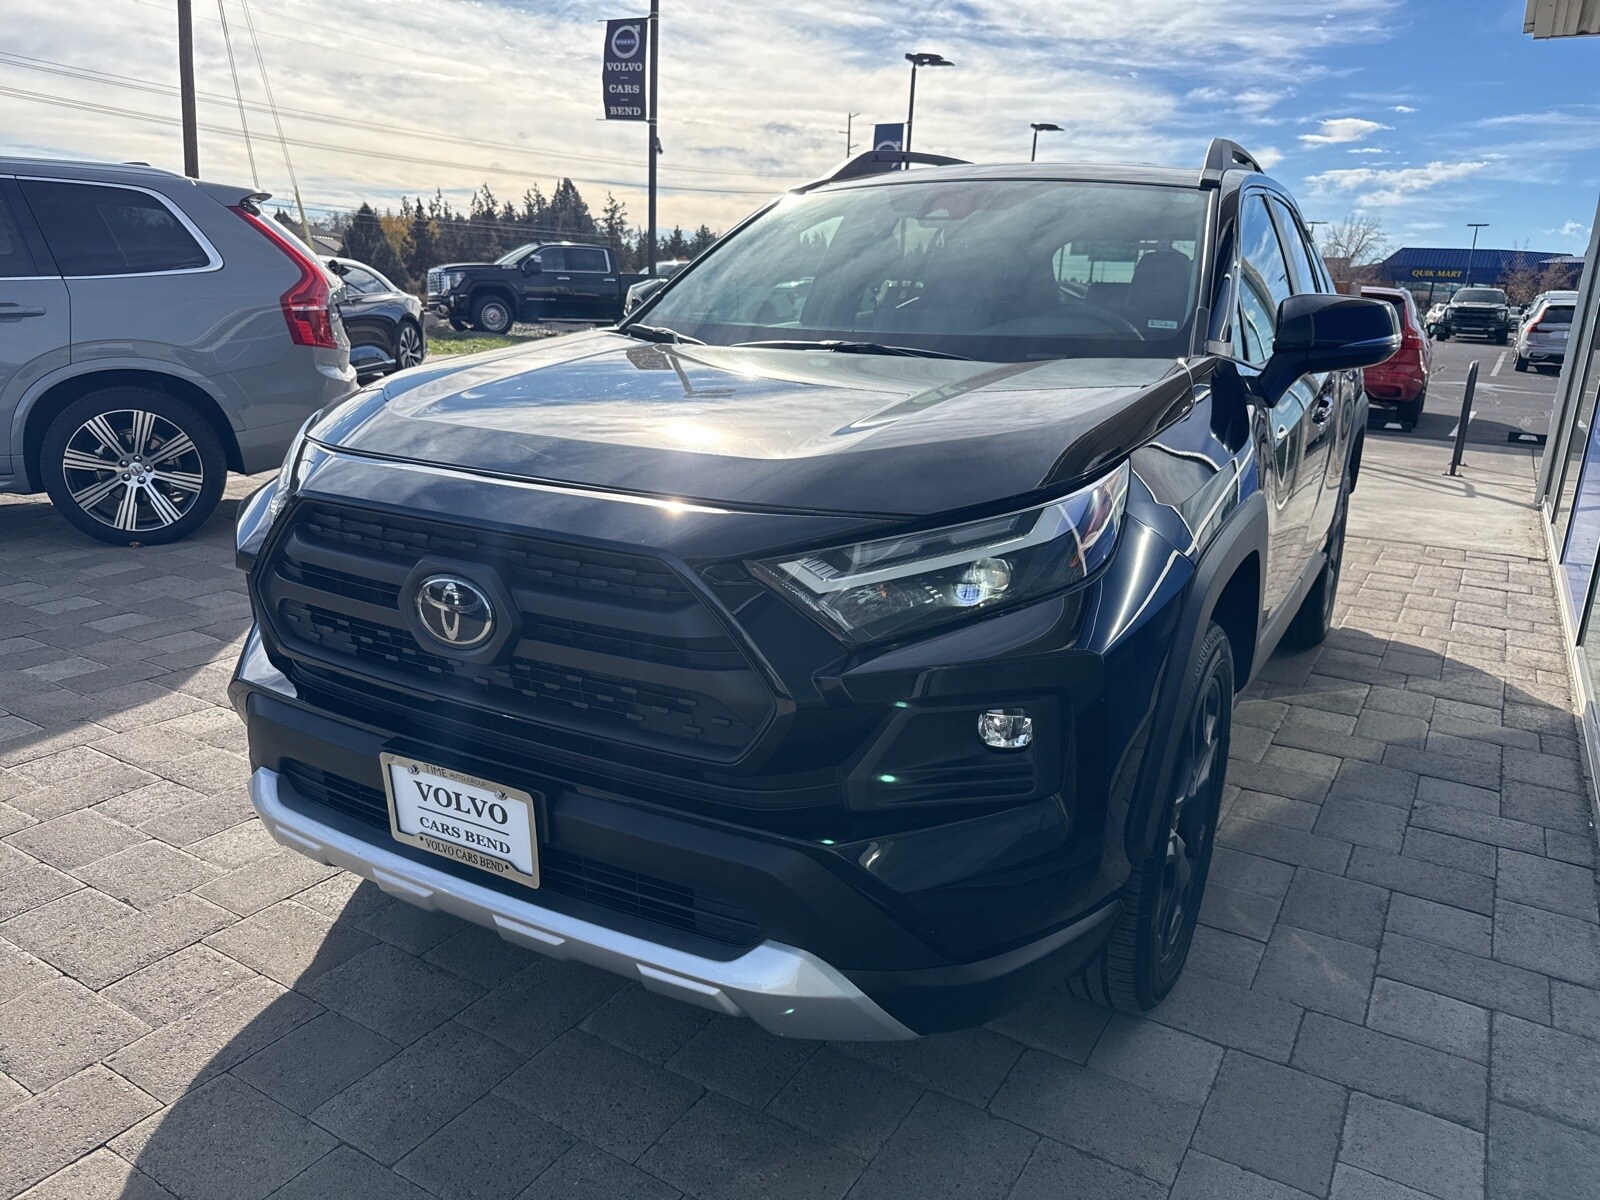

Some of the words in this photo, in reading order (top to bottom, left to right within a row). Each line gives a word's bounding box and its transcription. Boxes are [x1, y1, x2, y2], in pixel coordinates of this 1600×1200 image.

[607, 63, 642, 71] VOLVO
[609, 85, 640, 93] CARS
[610, 107, 641, 115] BEND
[1412, 270, 1433, 278] QUIK
[424, 764, 447, 777] TIME
[450, 772, 466, 782] AUTO
[467, 778, 487, 787] GROUP
[413, 780, 508, 825] VOLVO
[419, 816, 461, 839] CARS
[464, 829, 511, 854] BEND
[424, 837, 455, 856] VOLVO
[455, 848, 479, 865] CARS
[479, 857, 504, 873] BEND
